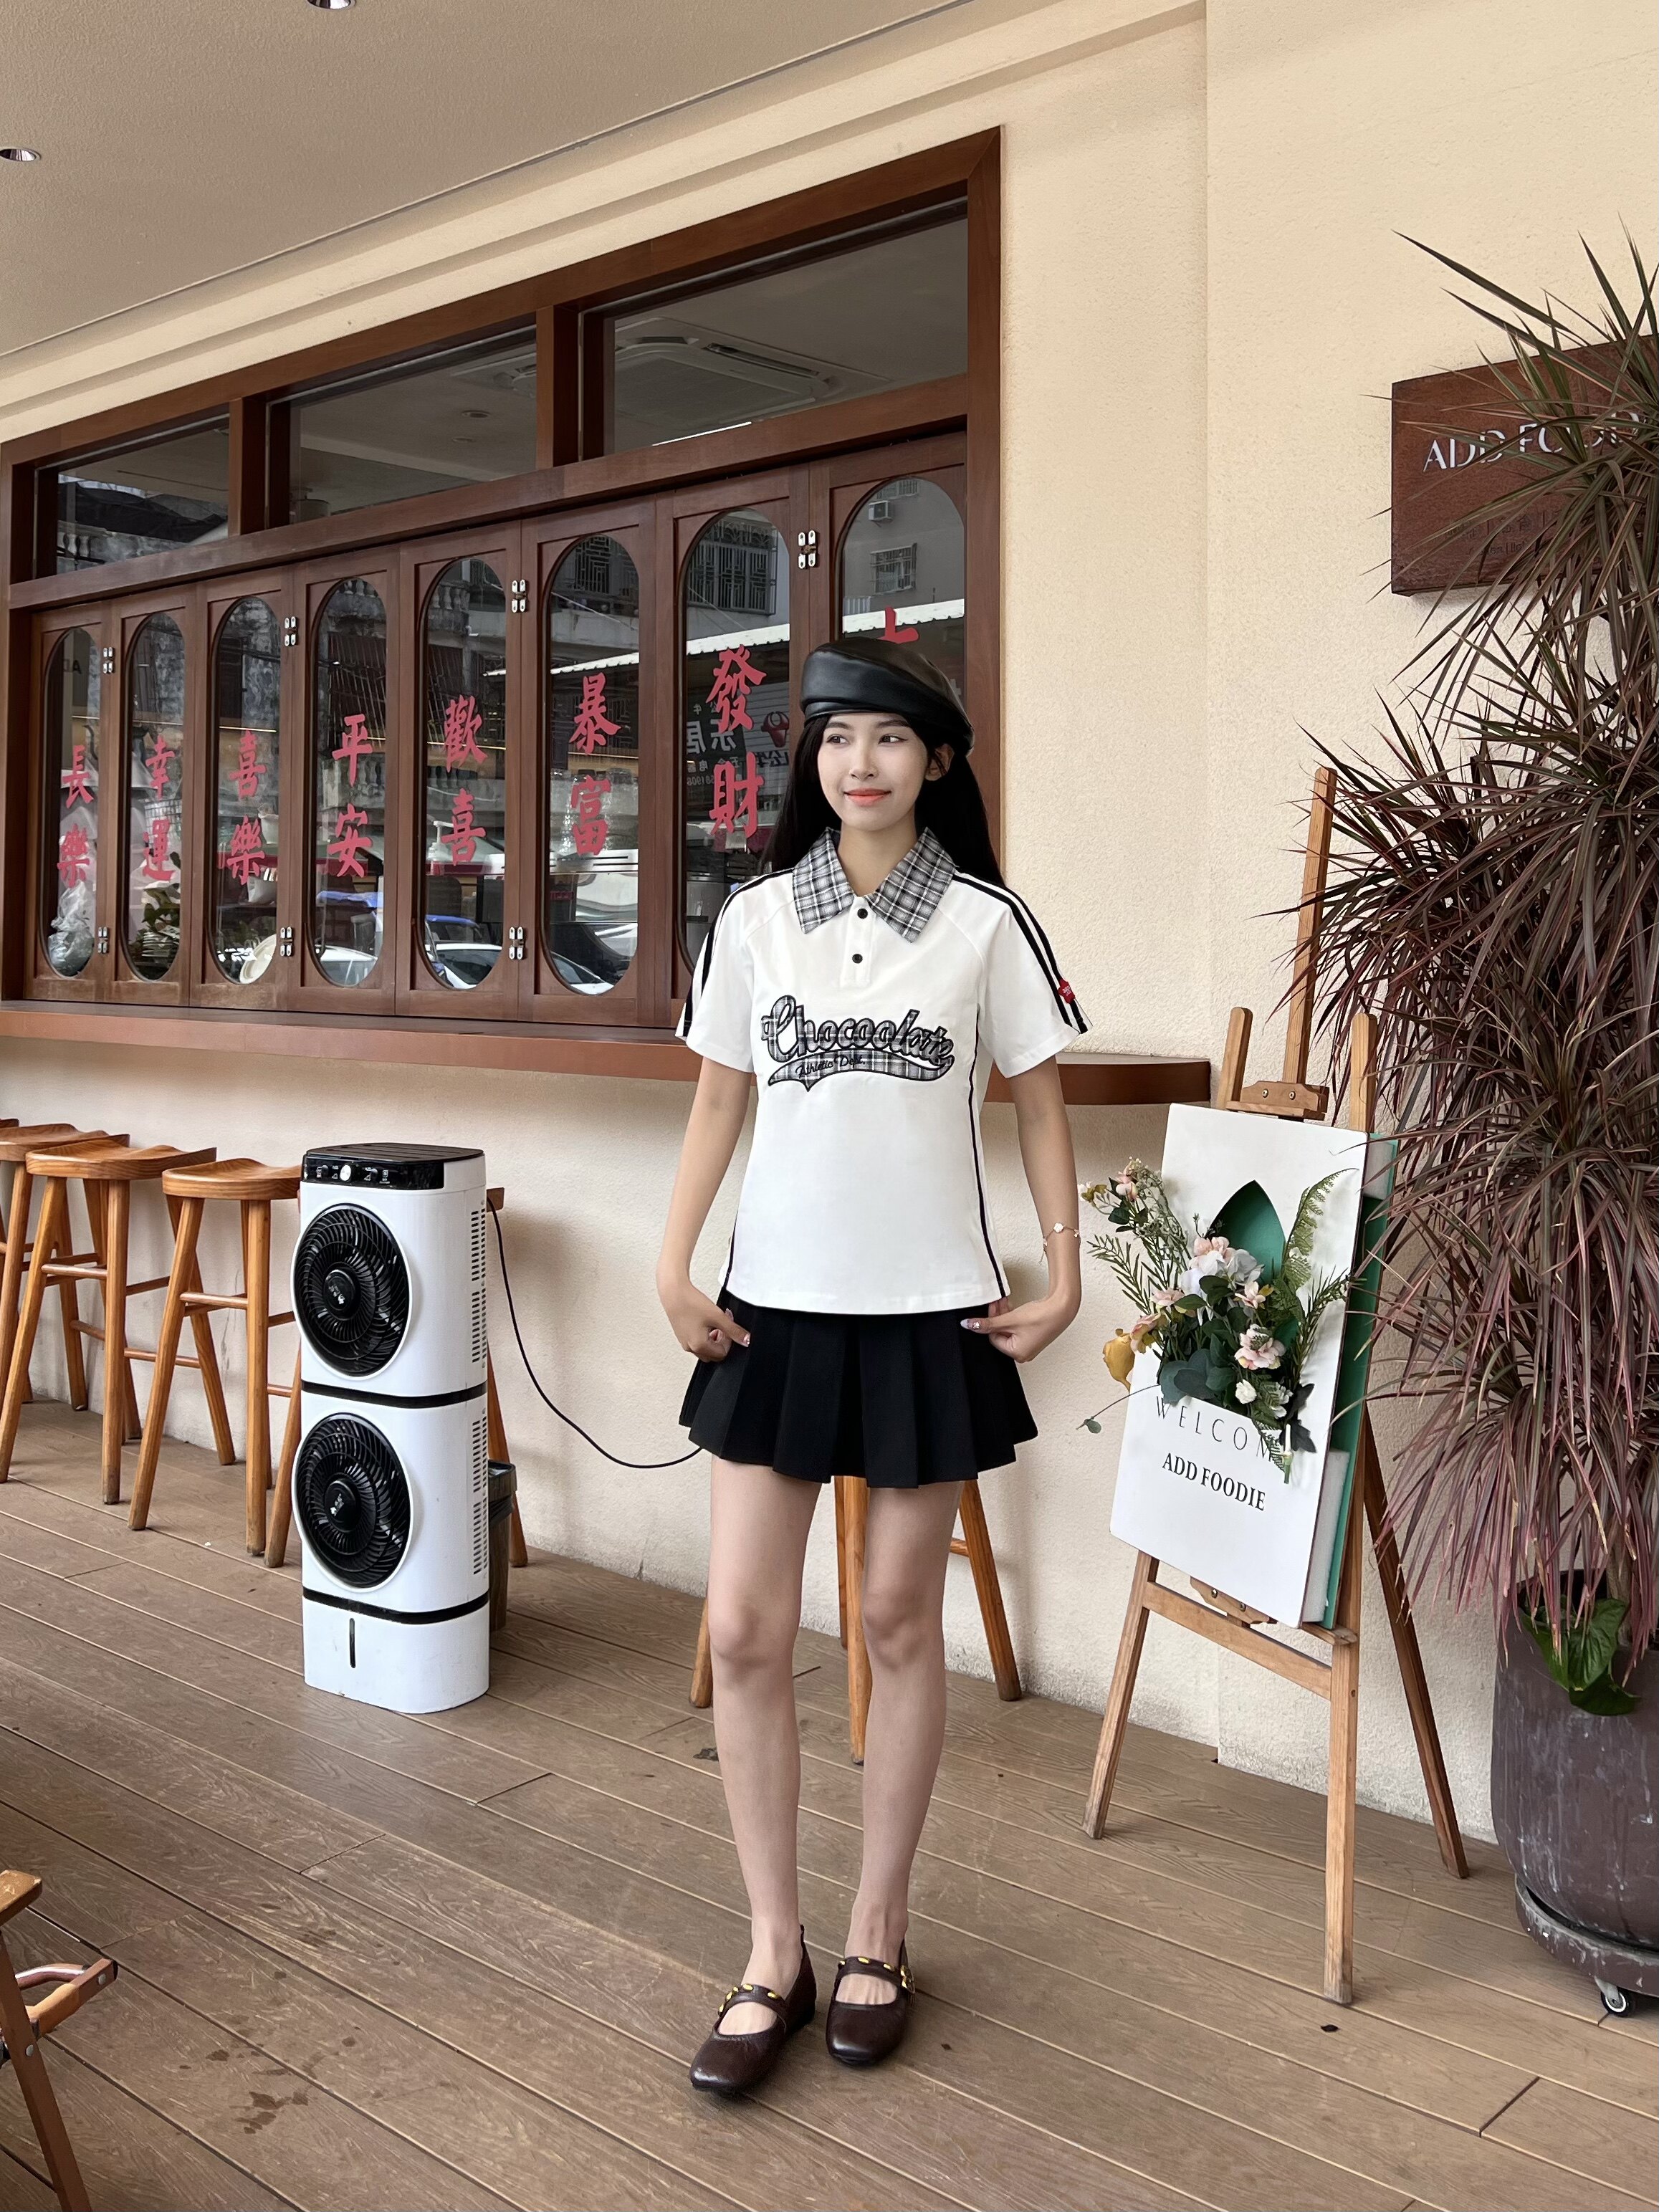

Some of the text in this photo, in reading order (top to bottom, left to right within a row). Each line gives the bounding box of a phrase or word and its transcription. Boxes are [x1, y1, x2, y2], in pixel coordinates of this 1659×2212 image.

[1423, 429, 1506, 473] ADD
[142, 733, 176, 881] 幸運
[226, 729, 267, 886] 喜樂
[327, 713, 373, 878] 平安
[440, 694, 488, 866] 歡喜
[569, 672, 622, 856] 暴富
[706, 643, 767, 838] 發財
[57, 744, 95, 889] 長樂
[760, 995, 955, 1066] Chocoolate
[795, 1056, 833, 1079] Athletic
[1156, 1395, 1273, 1462] WELCOM
[1162, 1452, 1266, 1511] ADD FOODIE
